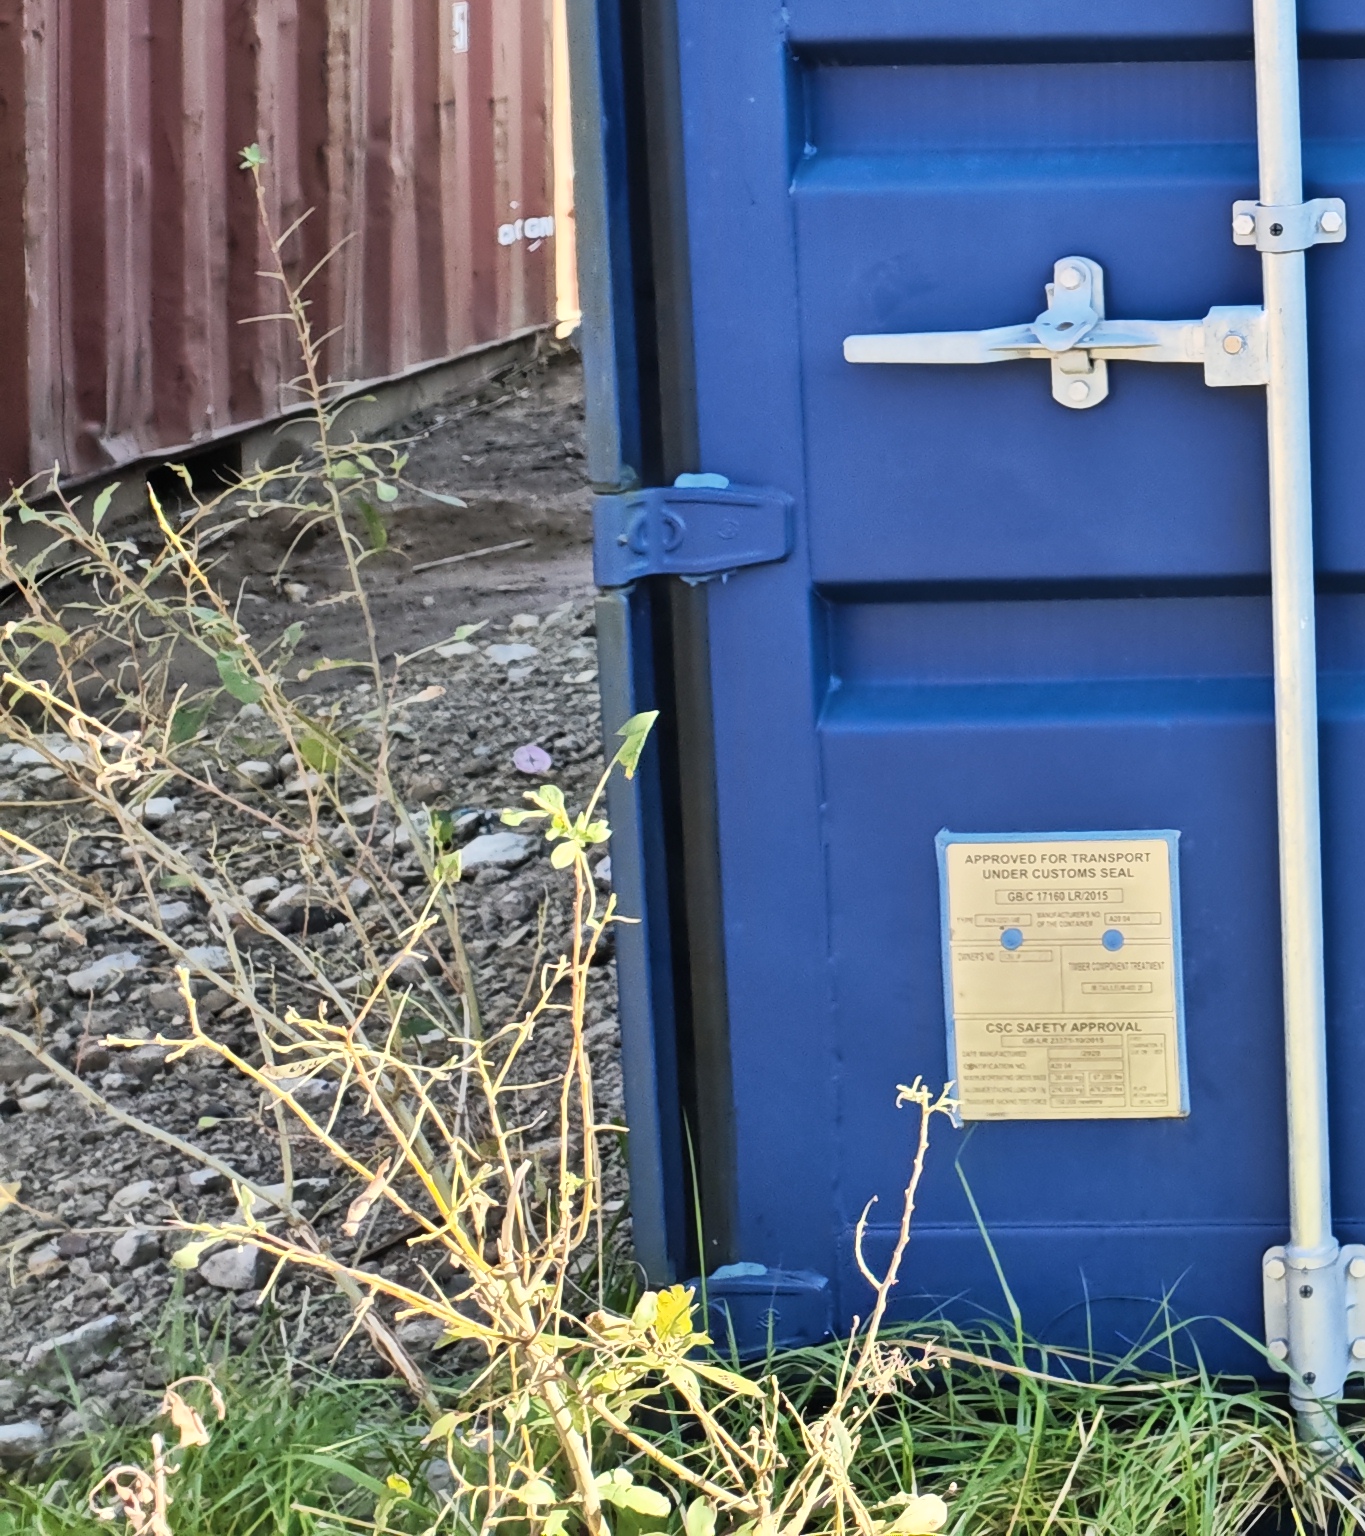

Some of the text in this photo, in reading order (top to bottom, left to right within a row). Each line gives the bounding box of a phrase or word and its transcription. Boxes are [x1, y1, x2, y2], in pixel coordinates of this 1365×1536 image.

[965, 852, 1151, 864] APPROVED FOR TRANSPORT
[982, 867, 1134, 879] UNDER CUSTOMS SEAL
[985, 1021, 1142, 1033] CSC SAFETY APPROVAL
